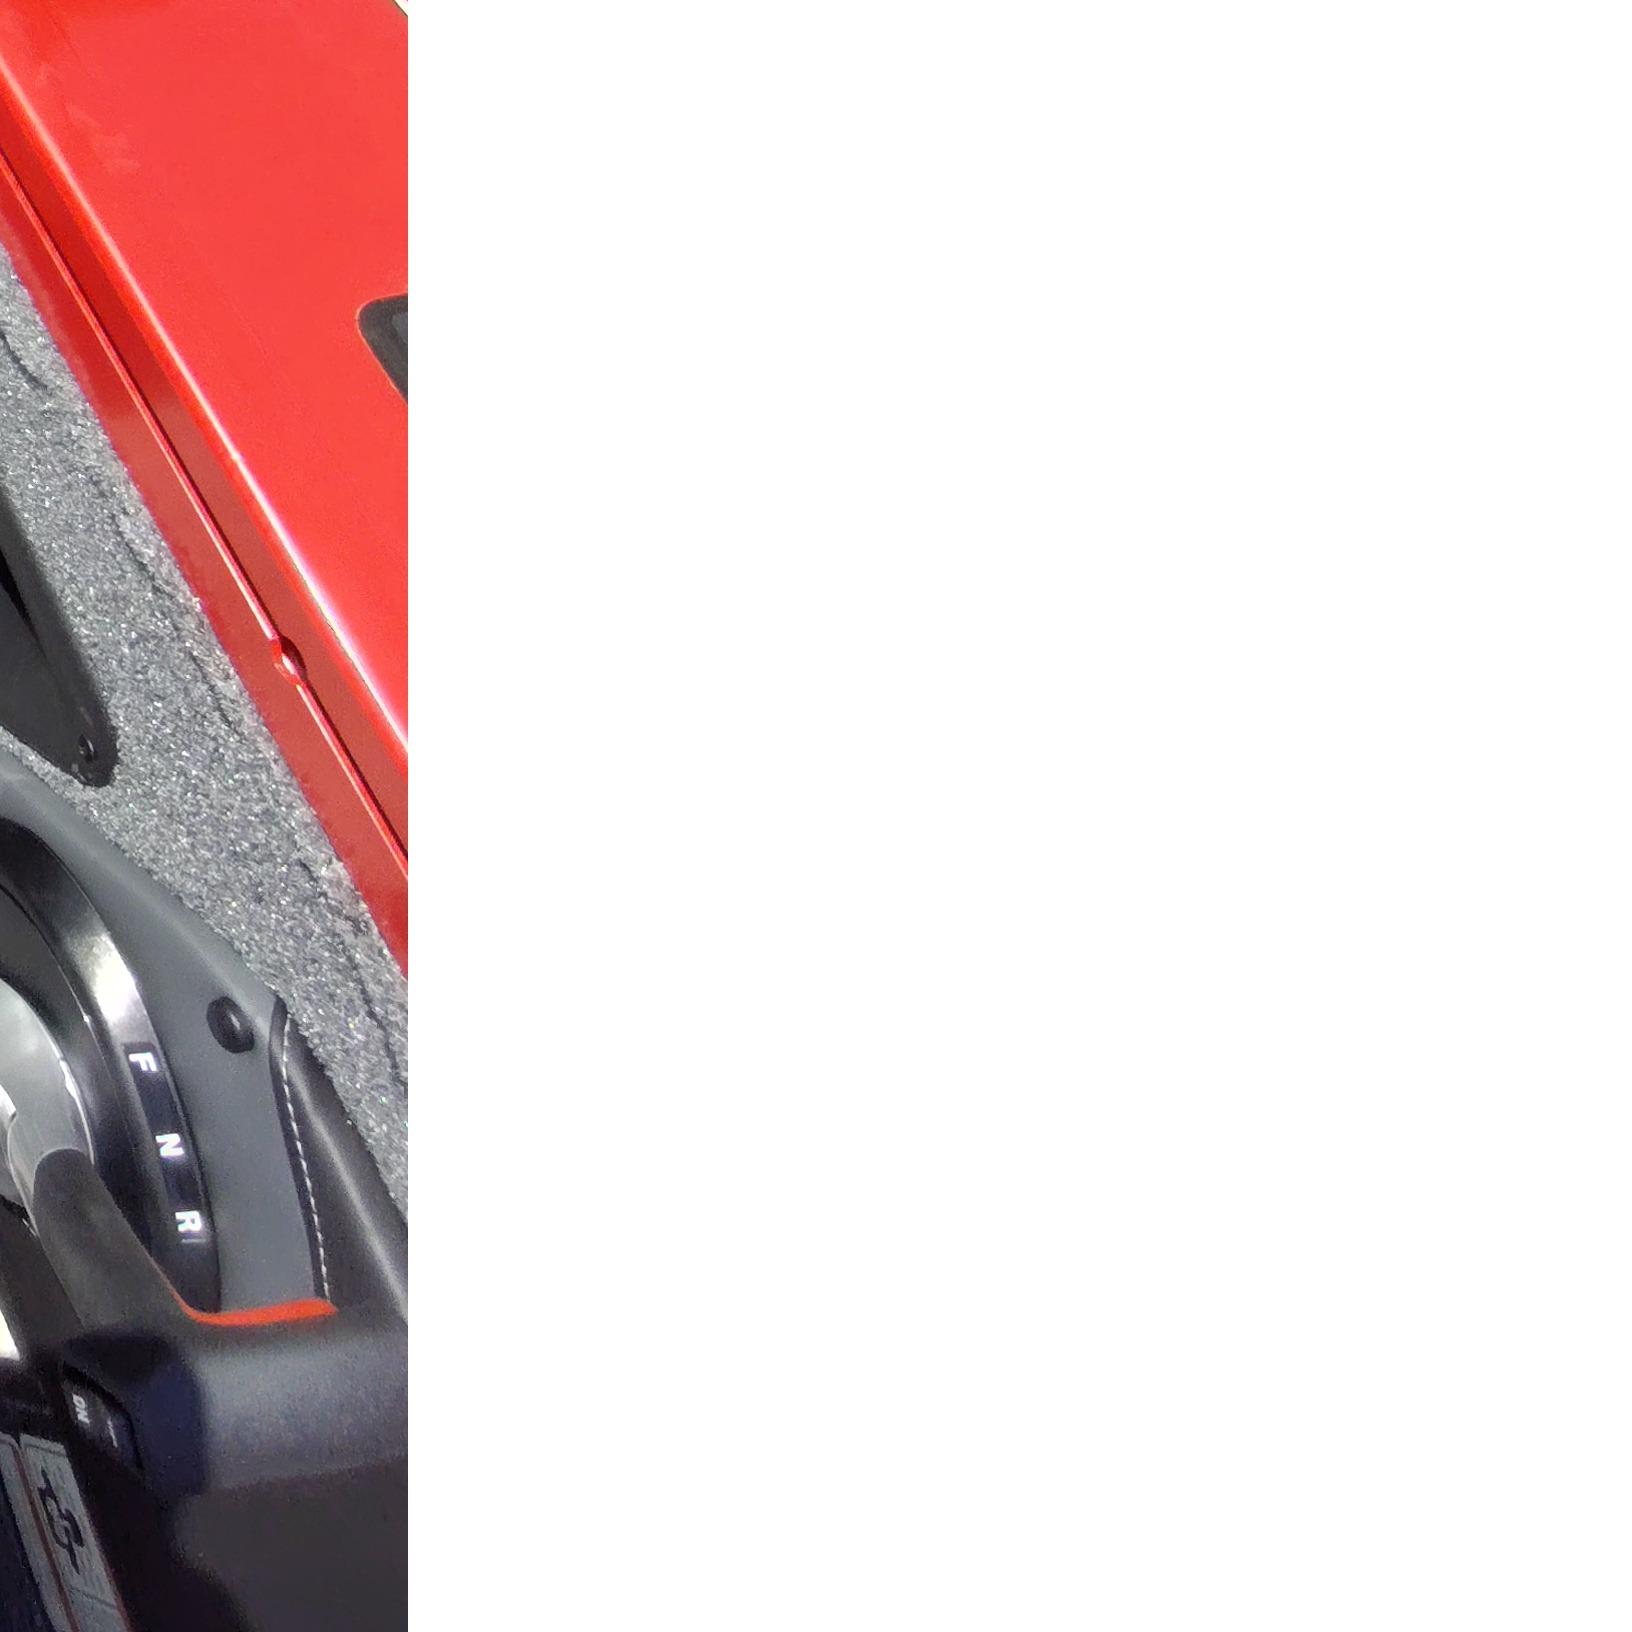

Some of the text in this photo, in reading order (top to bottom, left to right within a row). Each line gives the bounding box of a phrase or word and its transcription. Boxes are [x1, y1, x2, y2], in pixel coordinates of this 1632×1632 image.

[128, 1052, 159, 1072] F
[155, 1133, 185, 1157] N
[175, 1210, 203, 1232] R
